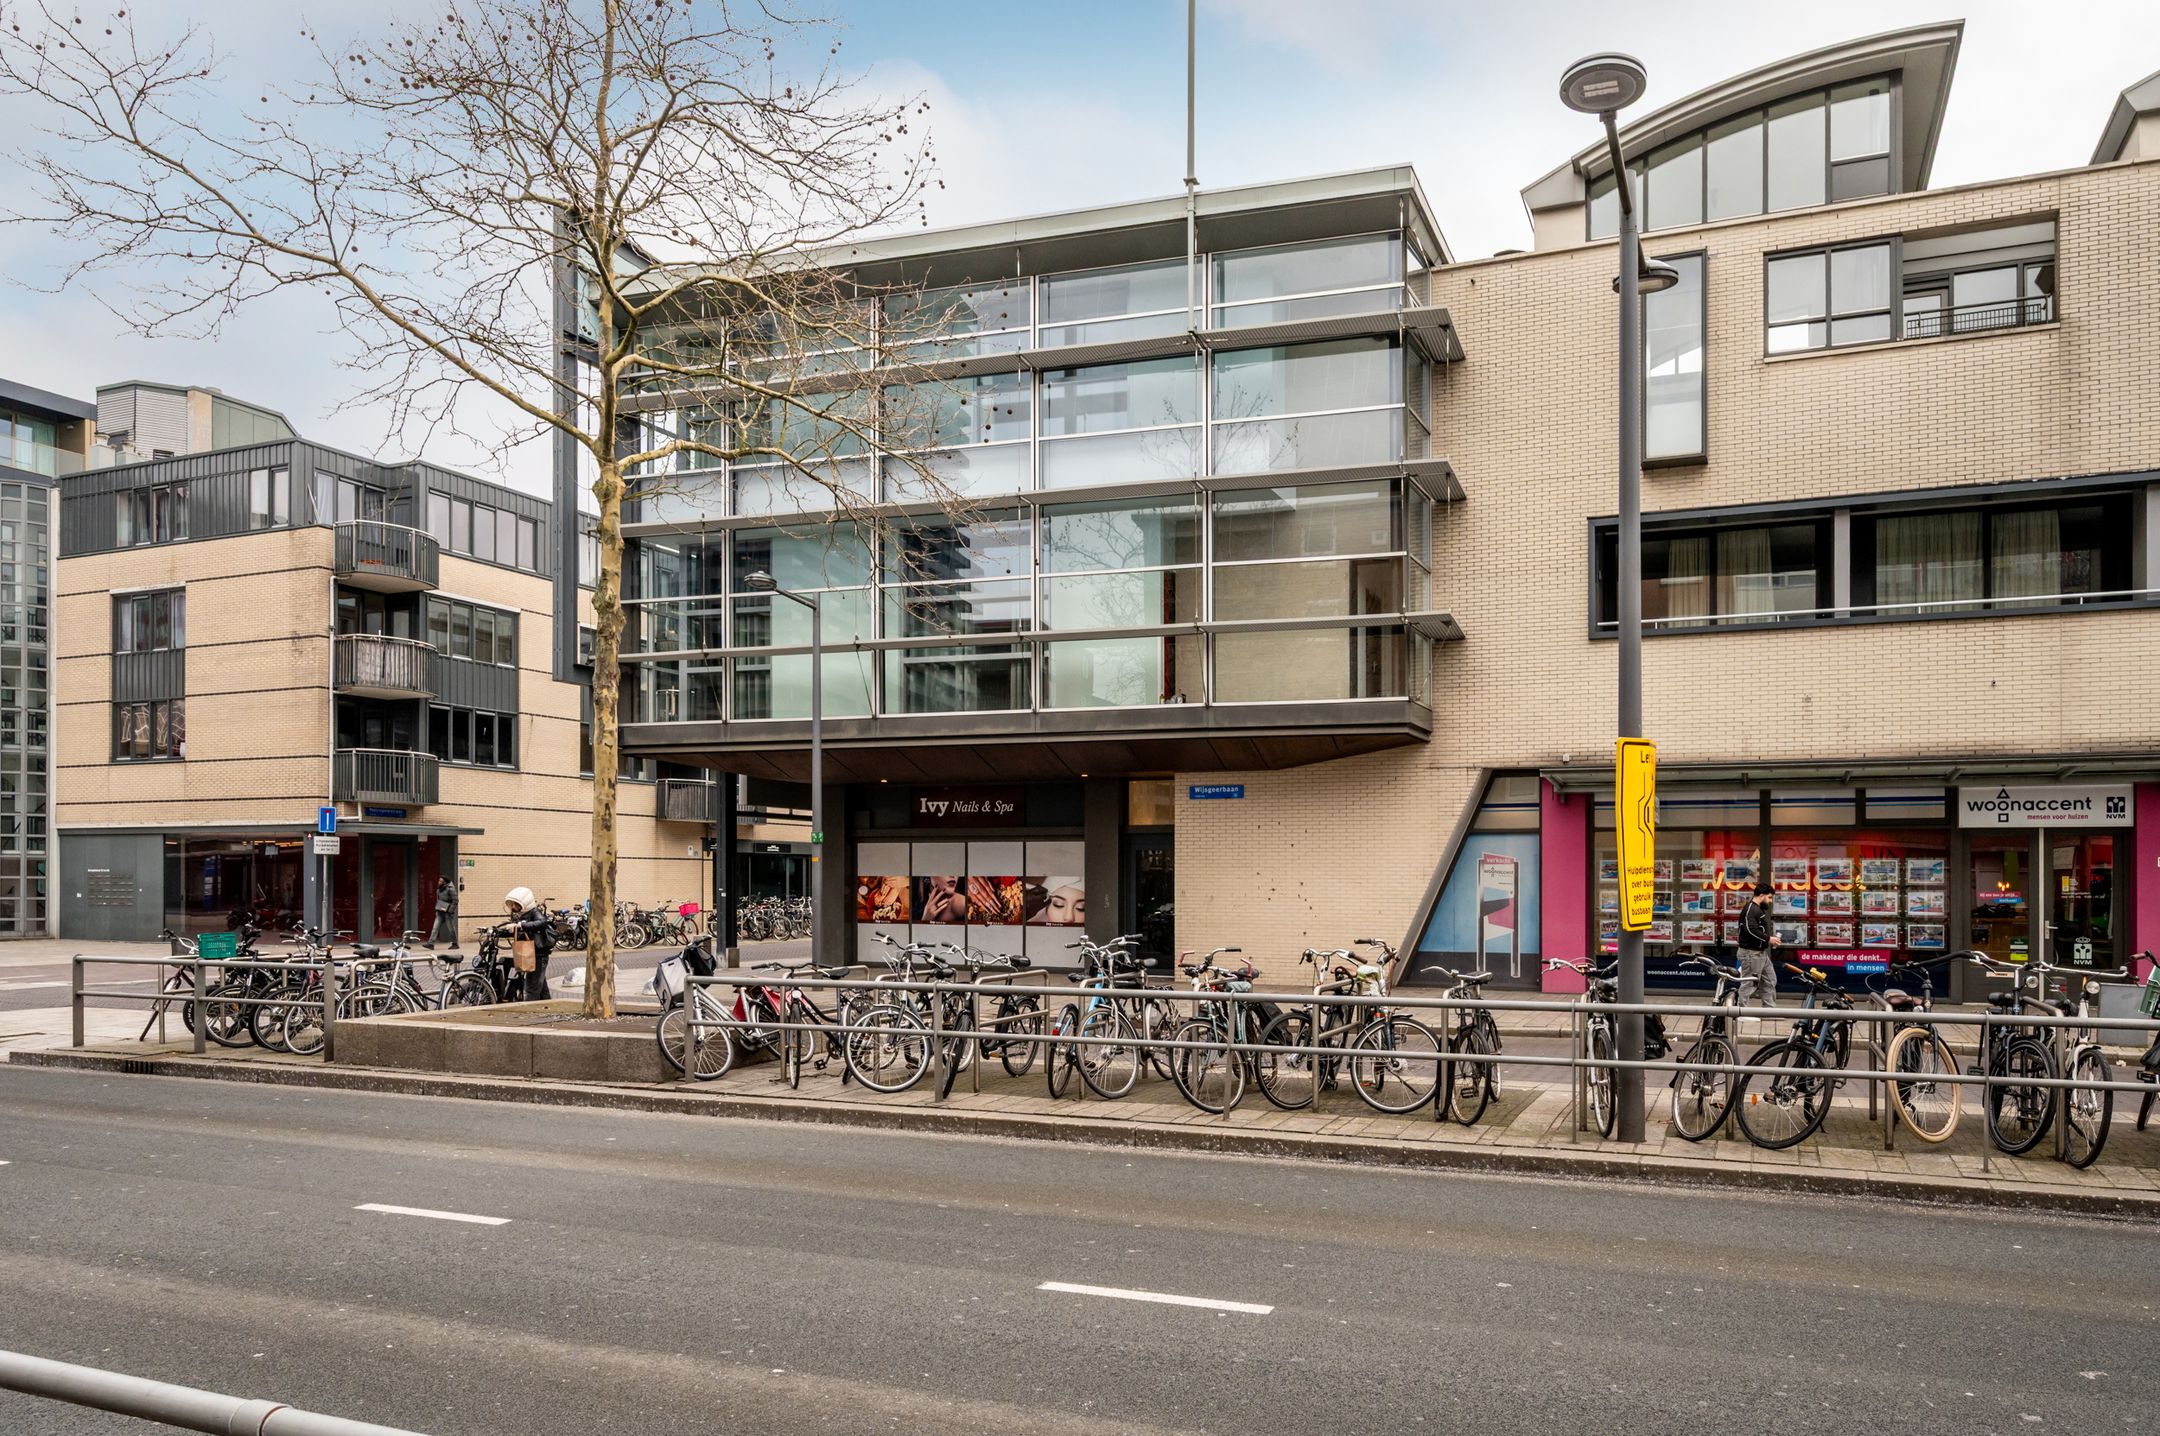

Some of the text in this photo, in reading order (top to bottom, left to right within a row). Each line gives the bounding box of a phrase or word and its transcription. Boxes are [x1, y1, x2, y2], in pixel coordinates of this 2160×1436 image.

[1194, 786, 1239, 794] Wijsgeerbaan
[920, 797, 1014, 817] Ivy Nails & Spa
[1967, 796, 2092, 812] woonaccent
[1812, 953, 1845, 961] makelaar
